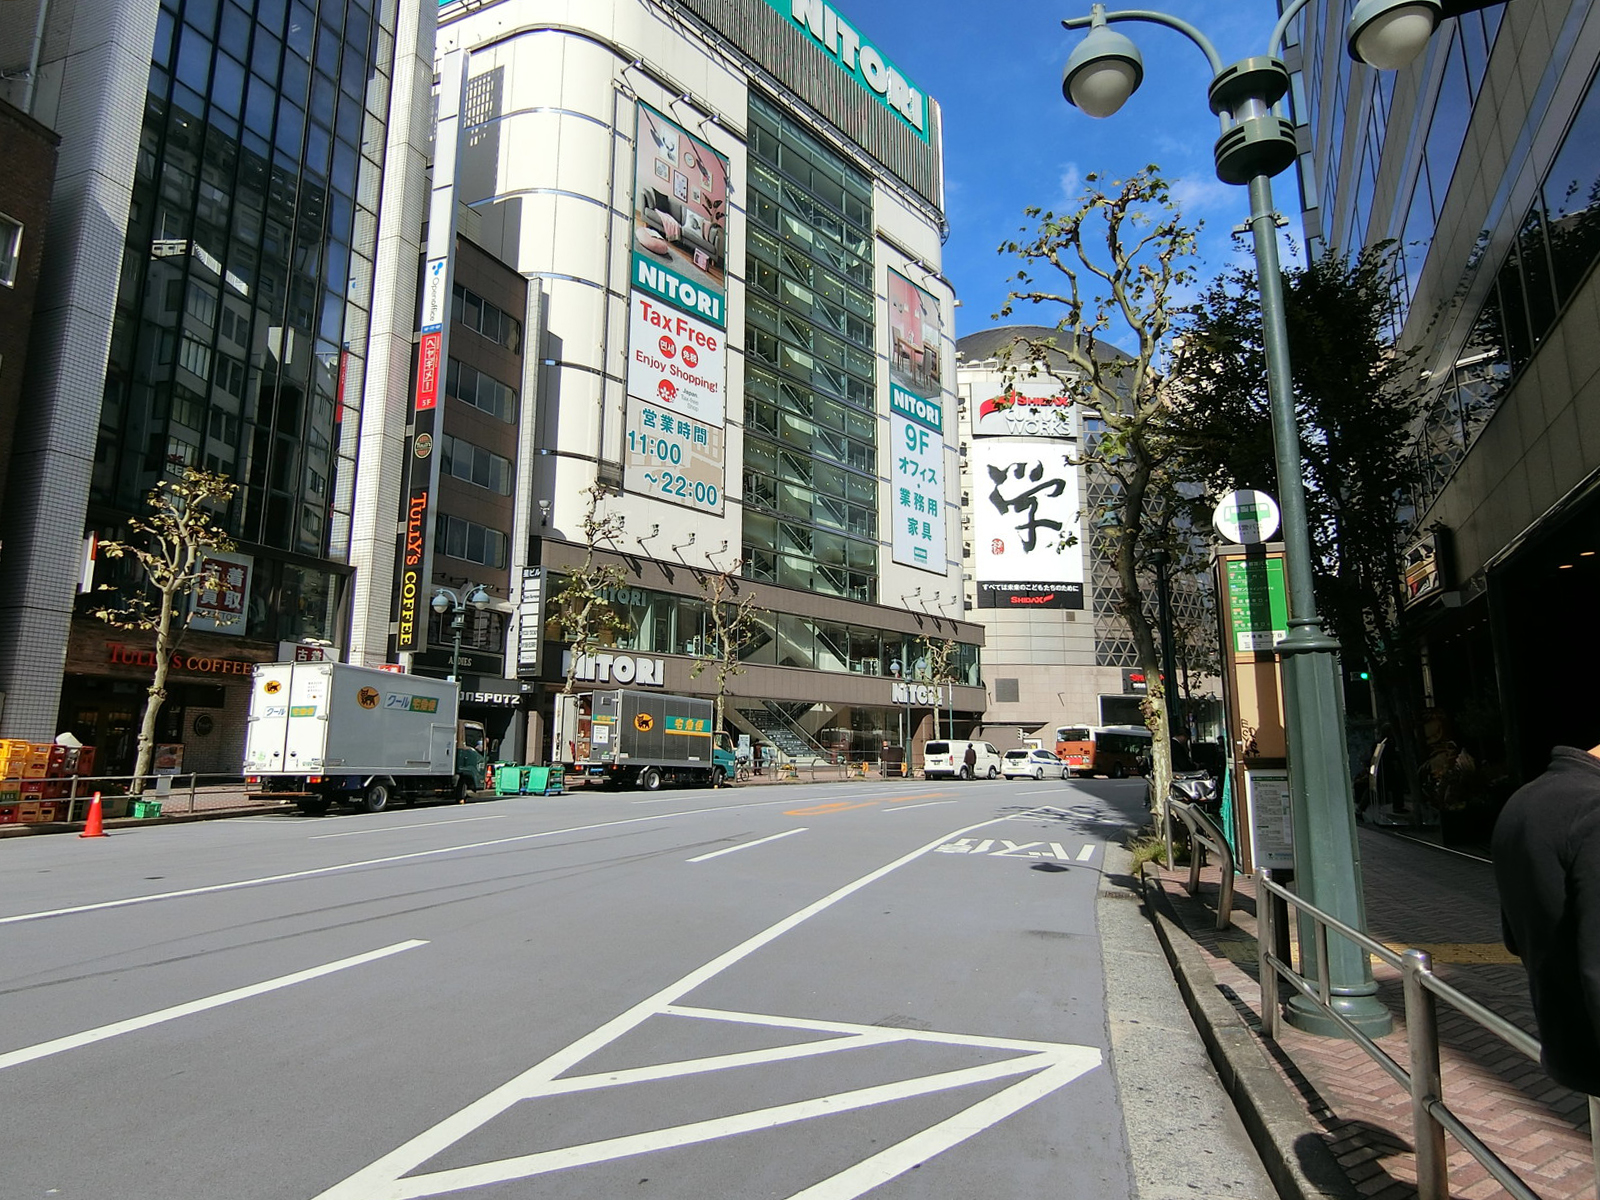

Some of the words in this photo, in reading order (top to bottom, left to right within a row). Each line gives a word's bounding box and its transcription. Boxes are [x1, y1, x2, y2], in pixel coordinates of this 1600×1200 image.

[791, 0, 922, 133] NITORI
[430, 277, 440, 322] Openoffice
[638, 260, 719, 320] NITORI
[640, 300, 672, 333] Tax
[676, 316, 718, 352] Free
[635, 349, 667, 373] Enjoy
[669, 364, 718, 394] Shopping!
[893, 388, 940, 426] NITORI
[642, 407, 707, 446] 営業時間
[905, 423, 930, 455] 9F
[1005, 420, 1071, 436] WORKS
[628, 430, 681, 466] 11:00
[899, 456, 938, 485] オフィス
[899, 486, 938, 518] 業務用
[406, 492, 427, 566] TULLY'S
[907, 516, 932, 541] 家具
[400, 571, 417, 645] COFFEE
[1010, 595, 1047, 604] SHIDAX
[106, 642, 183, 669] TULL'S
[186, 655, 251, 676] COFFEE
[448, 655, 473, 667] ADIES
[266, 707, 285, 716] クール
[386, 694, 410, 709] クール
[674, 717, 704, 732] 宅急便
